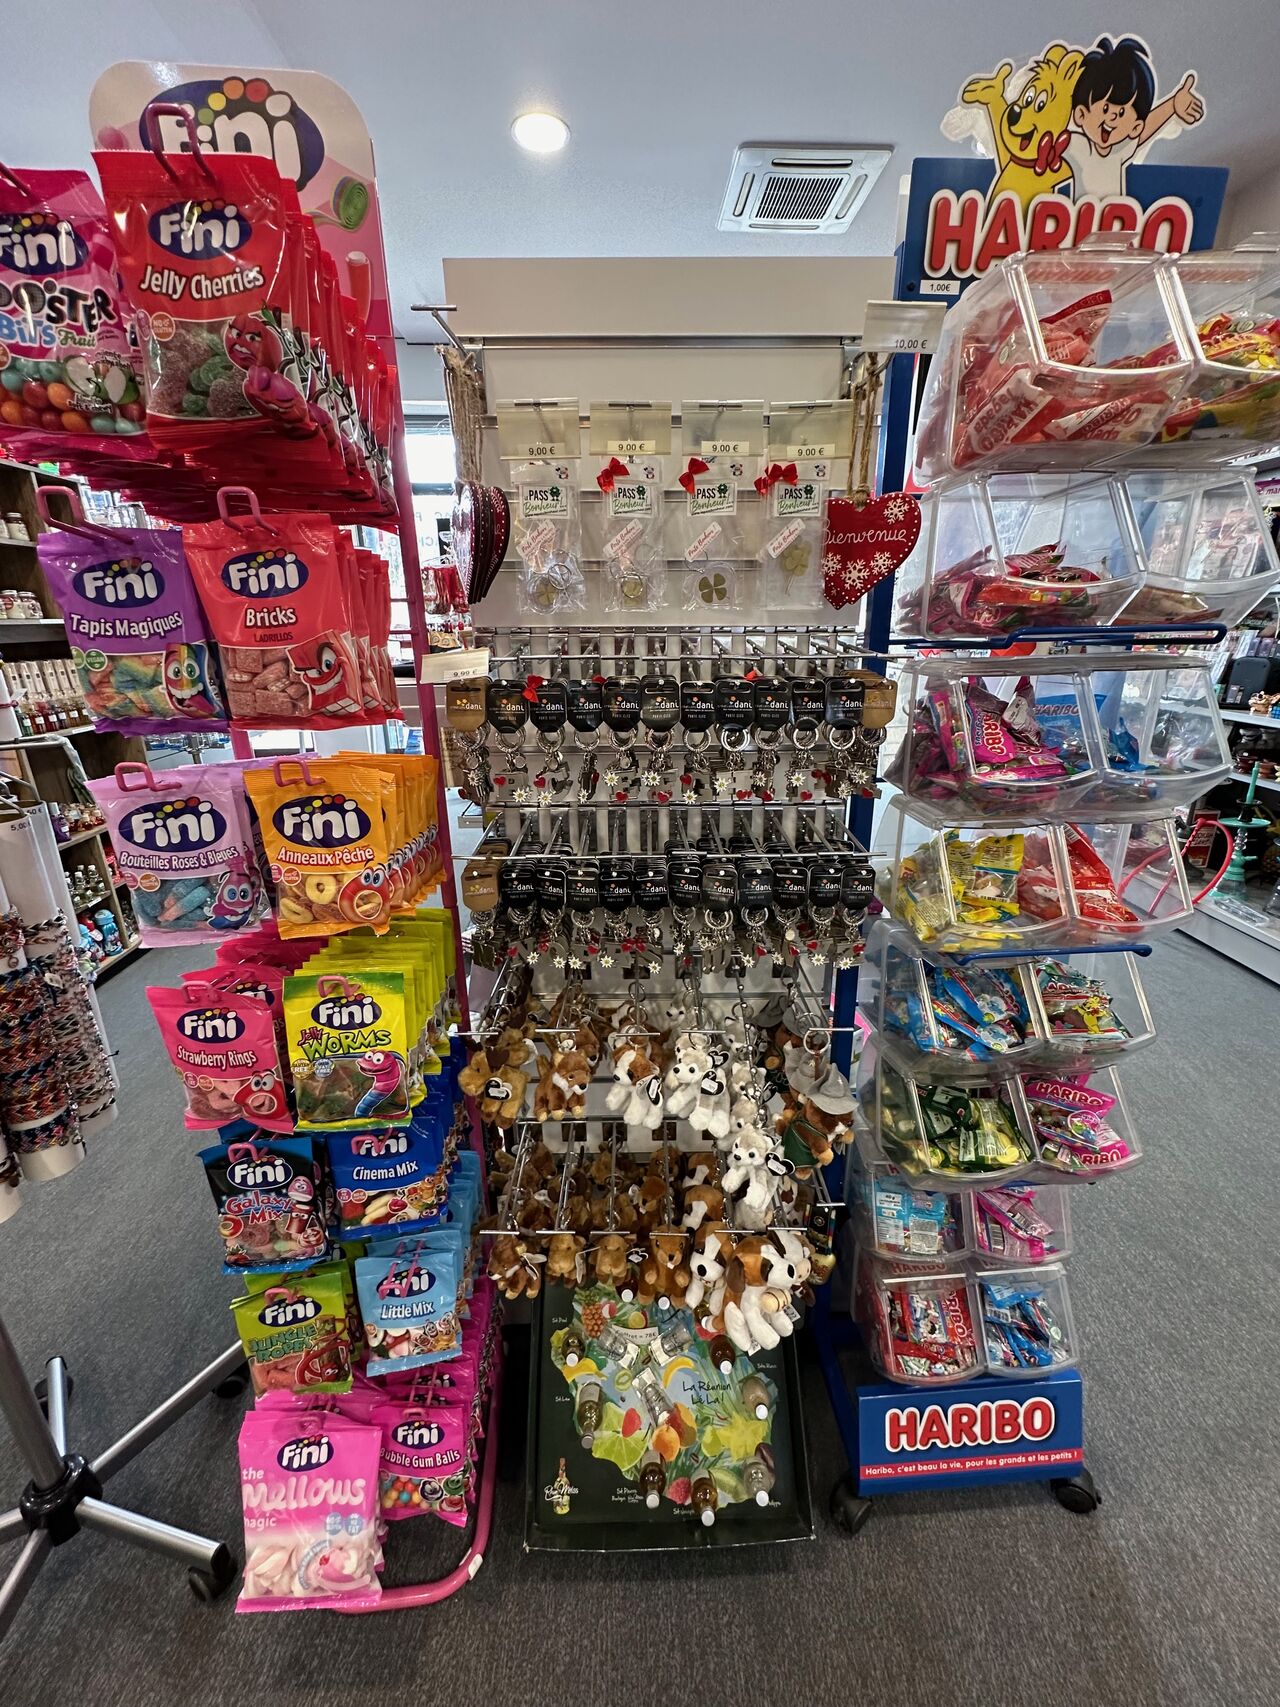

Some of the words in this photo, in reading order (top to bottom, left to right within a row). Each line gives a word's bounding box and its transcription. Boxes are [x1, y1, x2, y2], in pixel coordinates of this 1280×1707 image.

[158, 204, 240, 254] Fini
[140, 265, 186, 300] Jelly
[190, 266, 265, 300] Cherries
[58, 328, 97, 347] Fruit
[895, 338, 919, 350] 10,00
[920, 338, 927, 349] €
[528, 447, 549, 456] 9,00
[549, 446, 556, 455] €
[638, 443, 646, 451] €
[732, 444, 739, 453] €
[818, 447, 825, 456] €
[528, 489, 549, 501] PASS
[617, 487, 636, 500] PASS
[696, 488, 716, 500] PASS
[784, 488, 803, 500] PASS
[822, 518, 907, 545] Bienvenue
[82, 562, 159, 603] Fini
[228, 553, 299, 594] Fini
[70, 613, 113, 639] Tapis
[116, 611, 183, 639] Magiques
[245, 607, 297, 627] Bricks
[253, 632, 293, 643] LADRILLOS
[465, 702, 482, 710] dani
[507, 702, 525, 711] dani
[545, 702, 564, 711] dani
[583, 701, 602, 709] dani
[620, 701, 639, 710] dani
[660, 700, 679, 709] dani
[696, 701, 715, 709] dani
[734, 700, 752, 709] dani
[770, 700, 788, 709] dani
[807, 701, 824, 709] dani
[844, 700, 863, 709] dani
[984, 712, 1006, 756] ARIBO
[131, 800, 216, 847] Fini
[283, 799, 359, 842] Fini
[119, 852, 170, 870] Bouteilles
[171, 854, 200, 869] Roses
[200, 852, 207, 867] &
[207, 846, 239, 864] Bleues
[277, 847, 335, 865] Anneaux
[335, 845, 375, 865] Pêche
[319, 996, 374, 1027] Fini
[184, 1011, 237, 1039] Fini
[297, 1026, 324, 1046] Jelly
[301, 1029, 392, 1062] WORMS
[177, 1045, 227, 1070] Strawberry
[227, 1050, 257, 1067] Rings
[1036, 1082, 1104, 1106] HARIBO
[234, 1159, 286, 1186] Fini
[353, 1166, 396, 1180] Cinema
[396, 1160, 419, 1177] Mix
[225, 1190, 293, 1216] Galaxy
[249, 1207, 284, 1225] Mix
[265, 1297, 316, 1325] Fini
[381, 1304, 412, 1319] Little
[412, 1301, 435, 1317] Mix
[249, 1325, 318, 1352] JUNGLE
[682, 1381, 696, 1392] La
[698, 1380, 732, 1391] Réunion
[887, 1399, 1053, 1450] HARIBO
[397, 1423, 439, 1446] Fini
[281, 1436, 329, 1468] Fini
[412, 1456, 435, 1468] Gum
[435, 1449, 461, 1466] Balls
[242, 1467, 265, 1479] the
[865, 1467, 896, 1476] Haribo,
[897, 1464, 916, 1473] c'est
[917, 1462, 938, 1472] beau
[939, 1461, 948, 1470] la
[949, 1460, 964, 1469] vie,
[965, 1459, 985, 1469] pour
[985, 1457, 997, 1466] les
[998, 1455, 1026, 1466] grands
[1027, 1454, 1037, 1463] et
[1037, 1452, 1049, 1462] les
[1050, 1451, 1072, 1462] petits
